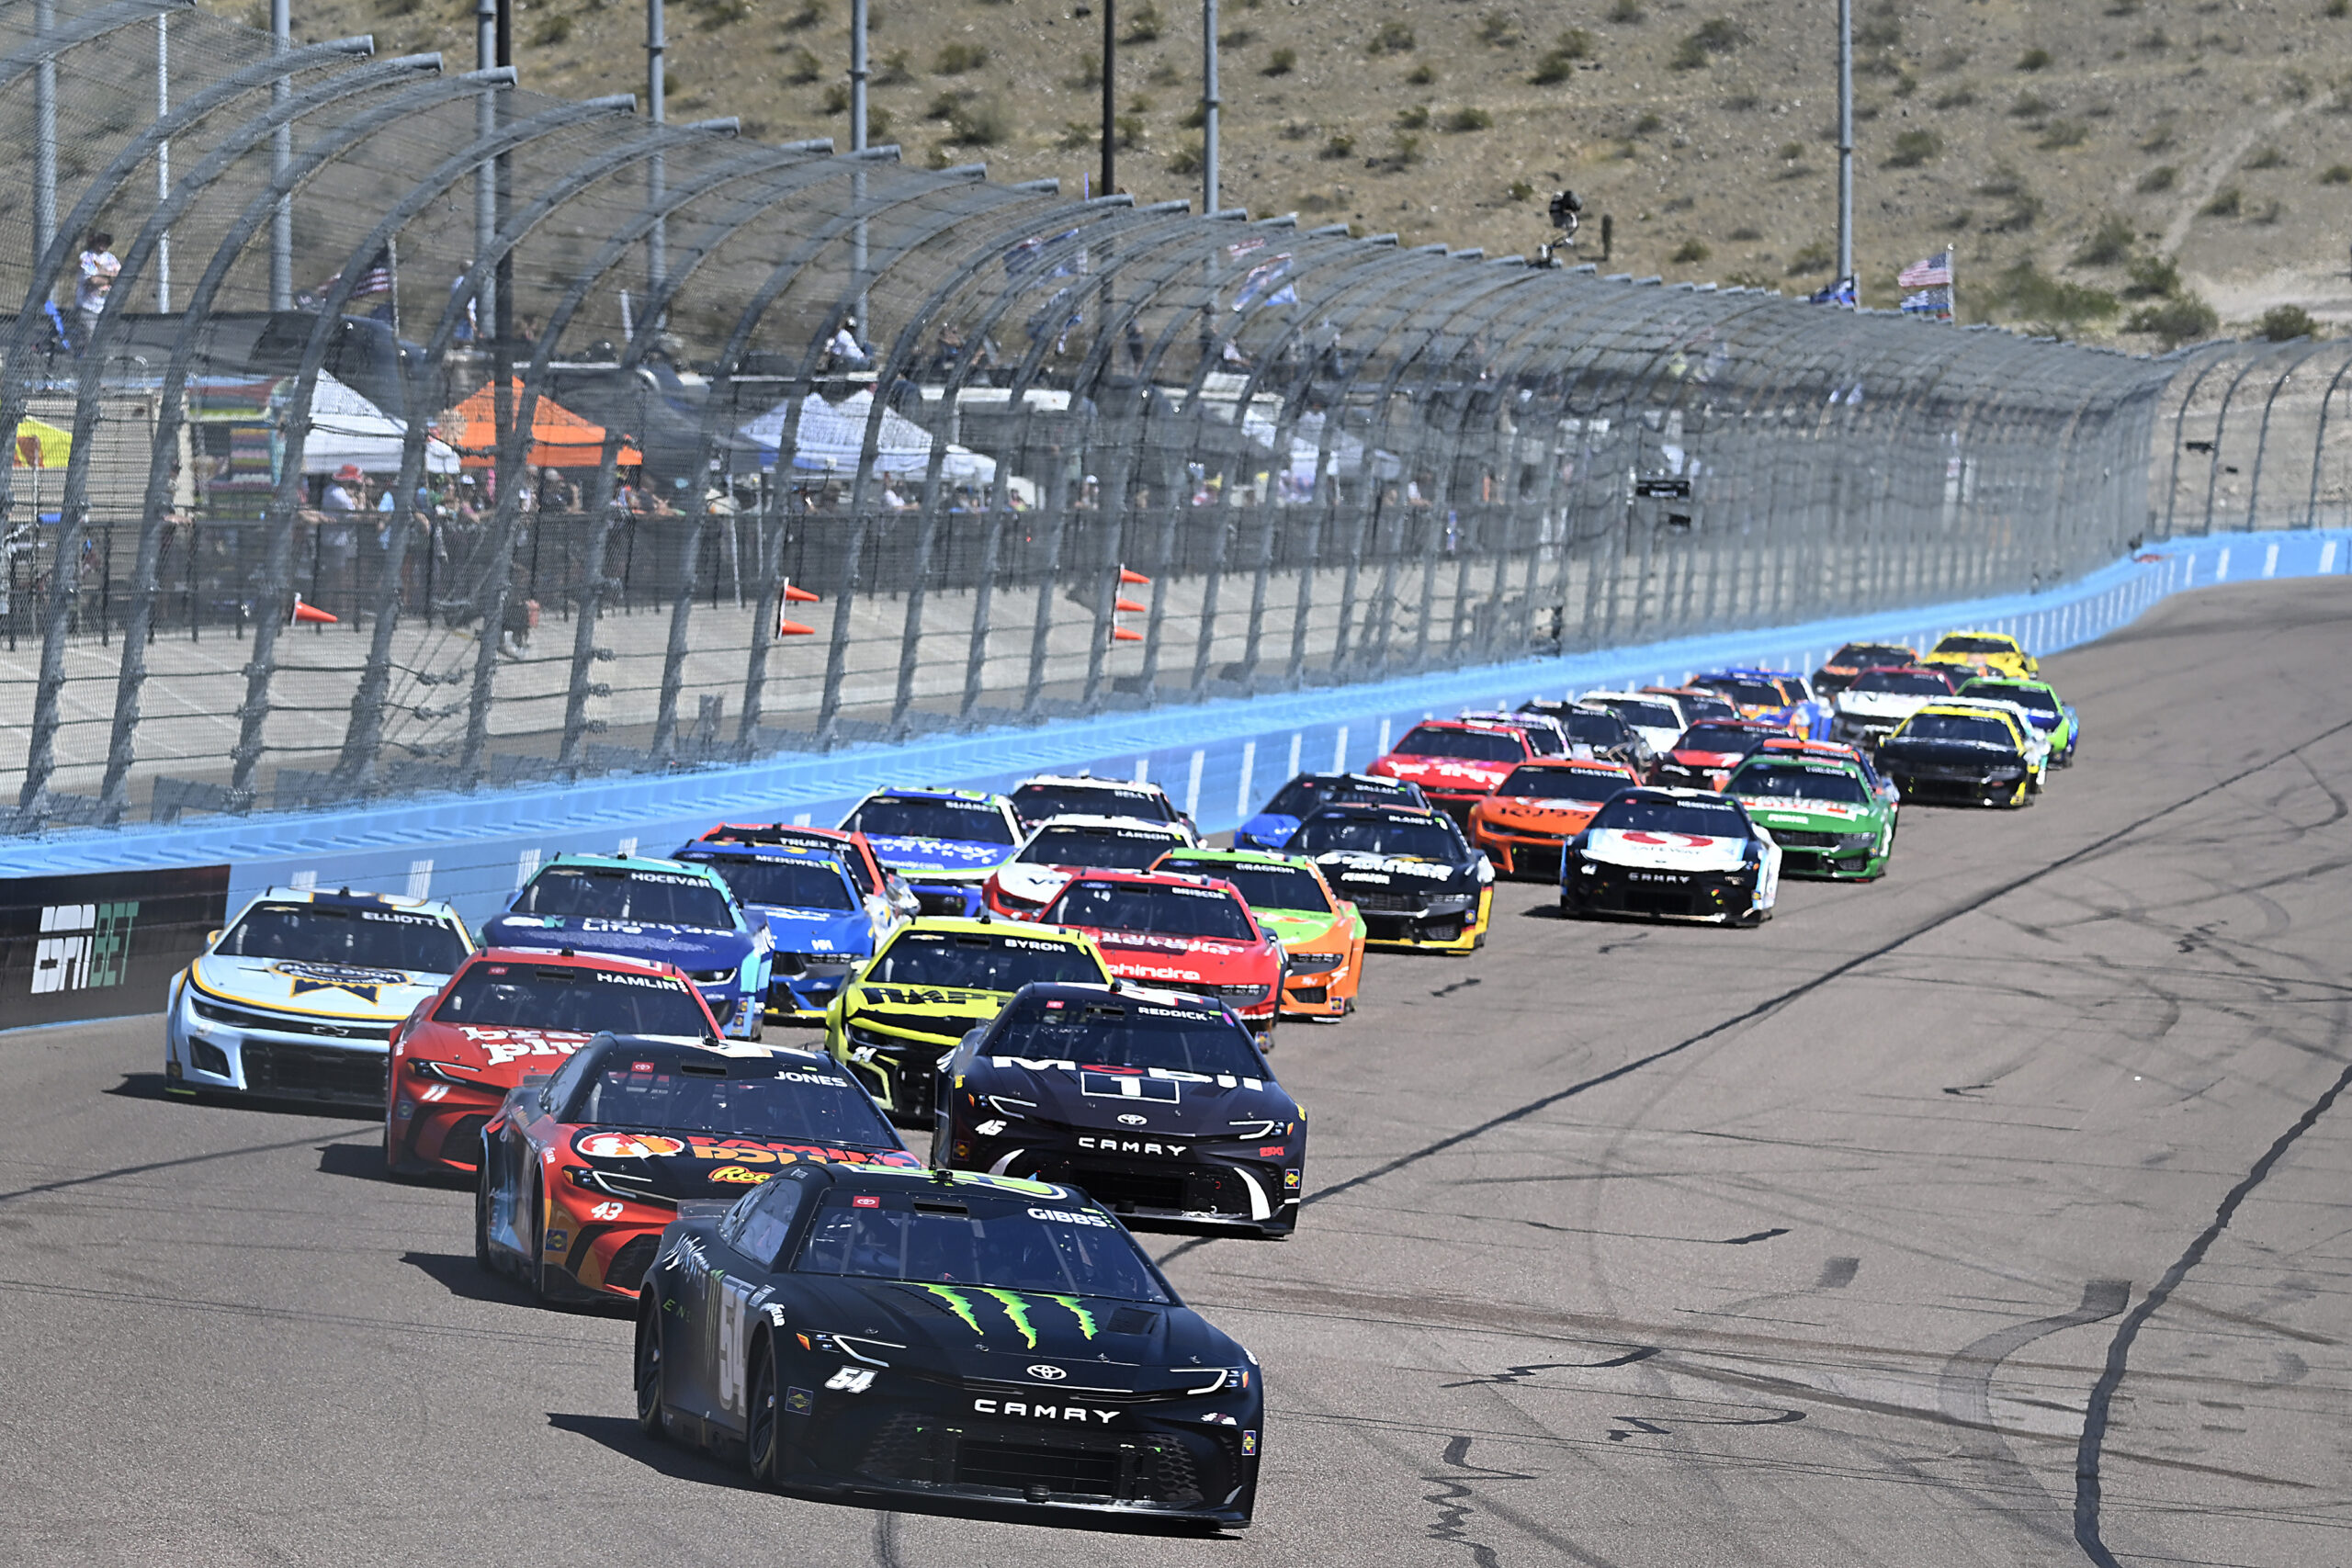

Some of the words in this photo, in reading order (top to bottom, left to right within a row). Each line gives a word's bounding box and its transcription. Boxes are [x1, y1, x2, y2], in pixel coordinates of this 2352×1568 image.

[631, 872, 712, 888] HOCEVAR
[362, 910, 435, 927] ELLIOTT
[1005, 938, 1066, 953] BYRON
[1105, 962, 1201, 981] ahindra
[597, 972, 678, 991] HAMLIN
[1138, 1006, 1208, 1021] REDDICK
[774, 1070, 848, 1089] JONES
[974, 1119, 1008, 1136] 45
[1078, 1136, 1187, 1157] CAMRY
[713, 1166, 772, 1183] Ree
[590, 1201, 625, 1221] 43
[1026, 1206, 1108, 1229] GIBBS
[824, 1364, 879, 1394] 54
[973, 1398, 1121, 1425] CAMRY
